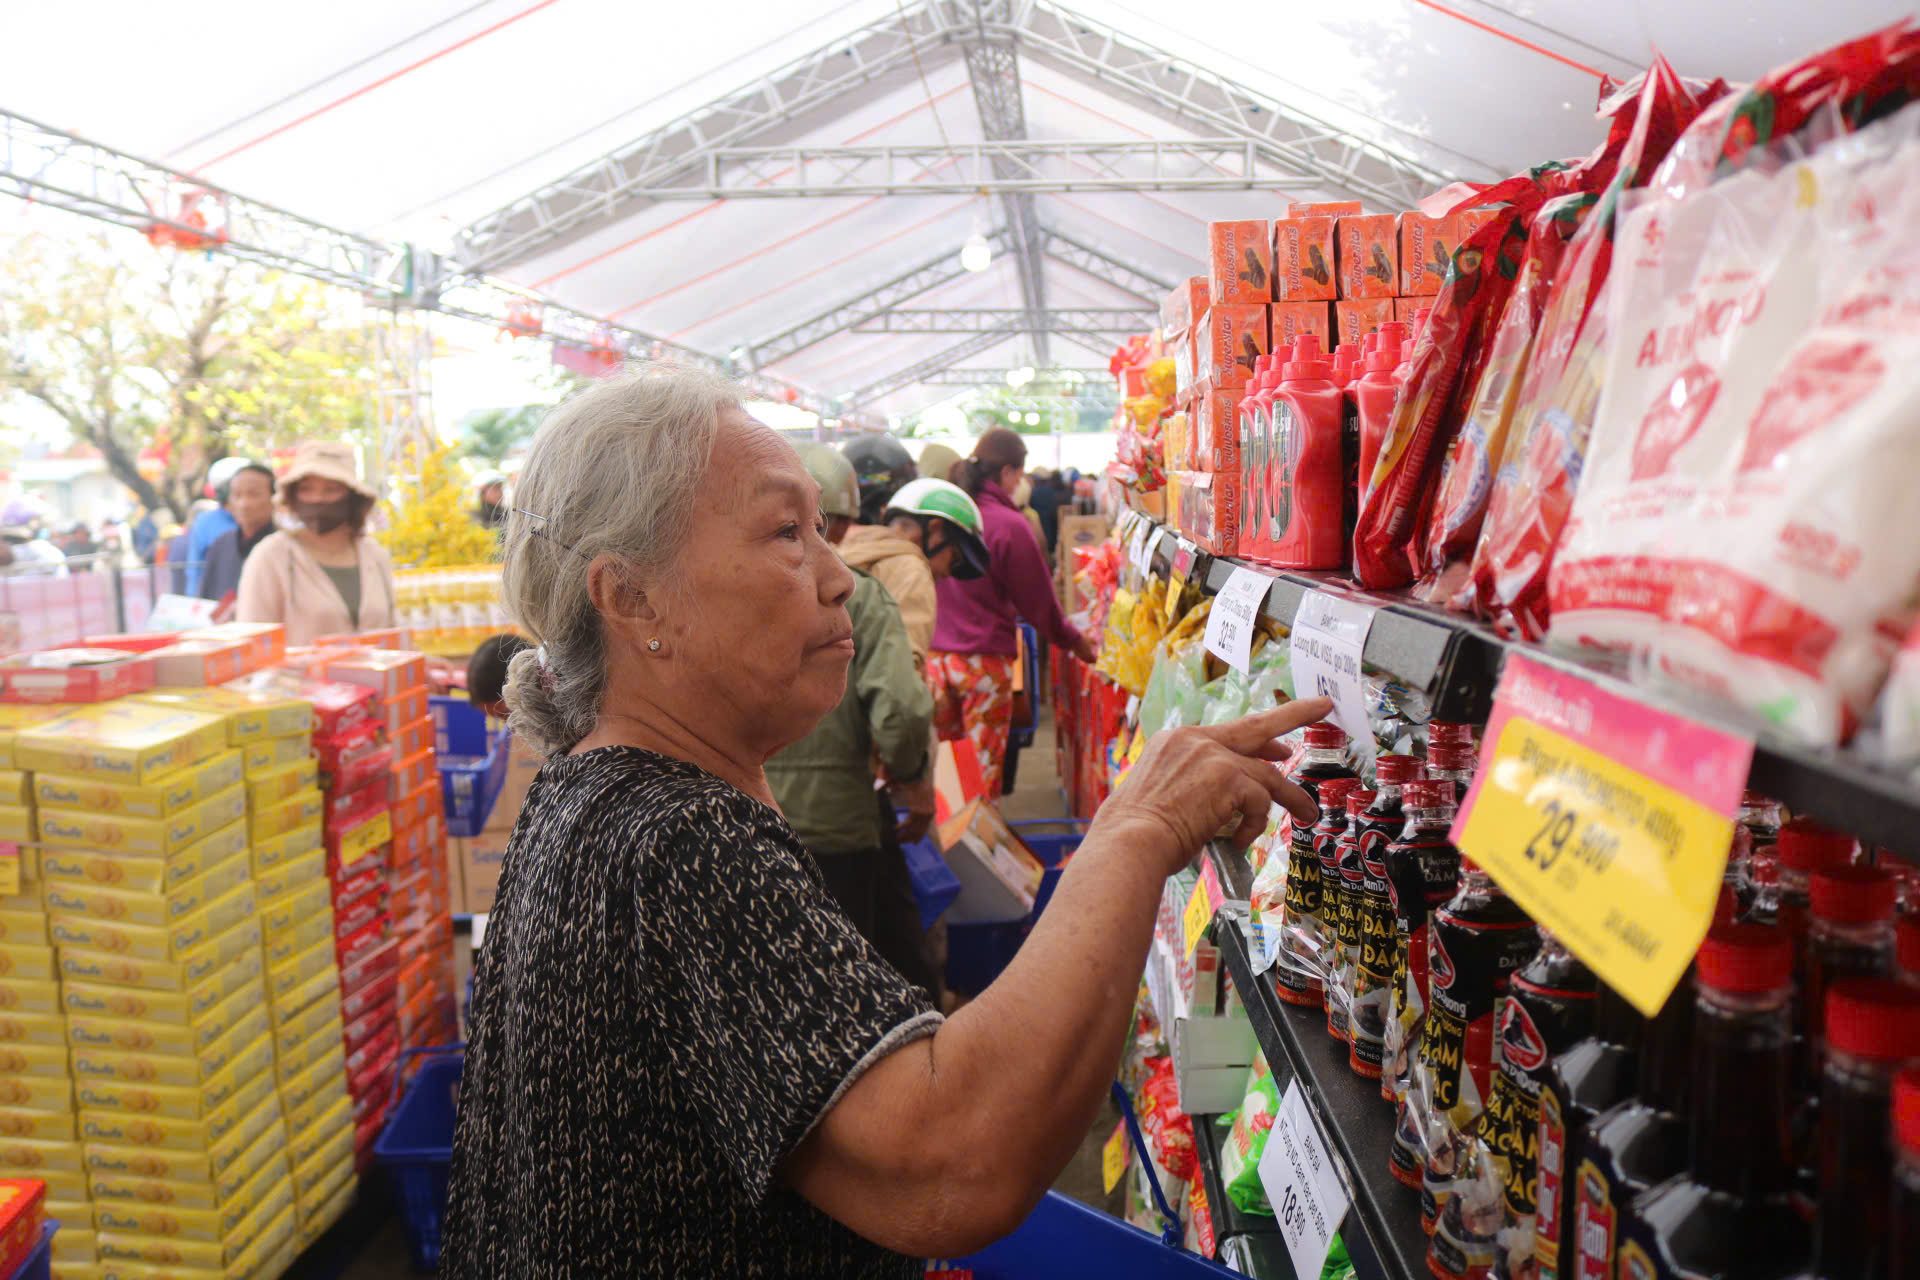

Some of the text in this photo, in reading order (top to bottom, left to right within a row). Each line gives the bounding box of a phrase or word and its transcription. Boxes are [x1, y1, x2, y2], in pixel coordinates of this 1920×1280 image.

[1350, 226, 1364, 290] Superstar
[1412, 222, 1425, 284] Superstar
[1224, 315, 1234, 377] Superstar
[1224, 482, 1235, 545] Superstar
